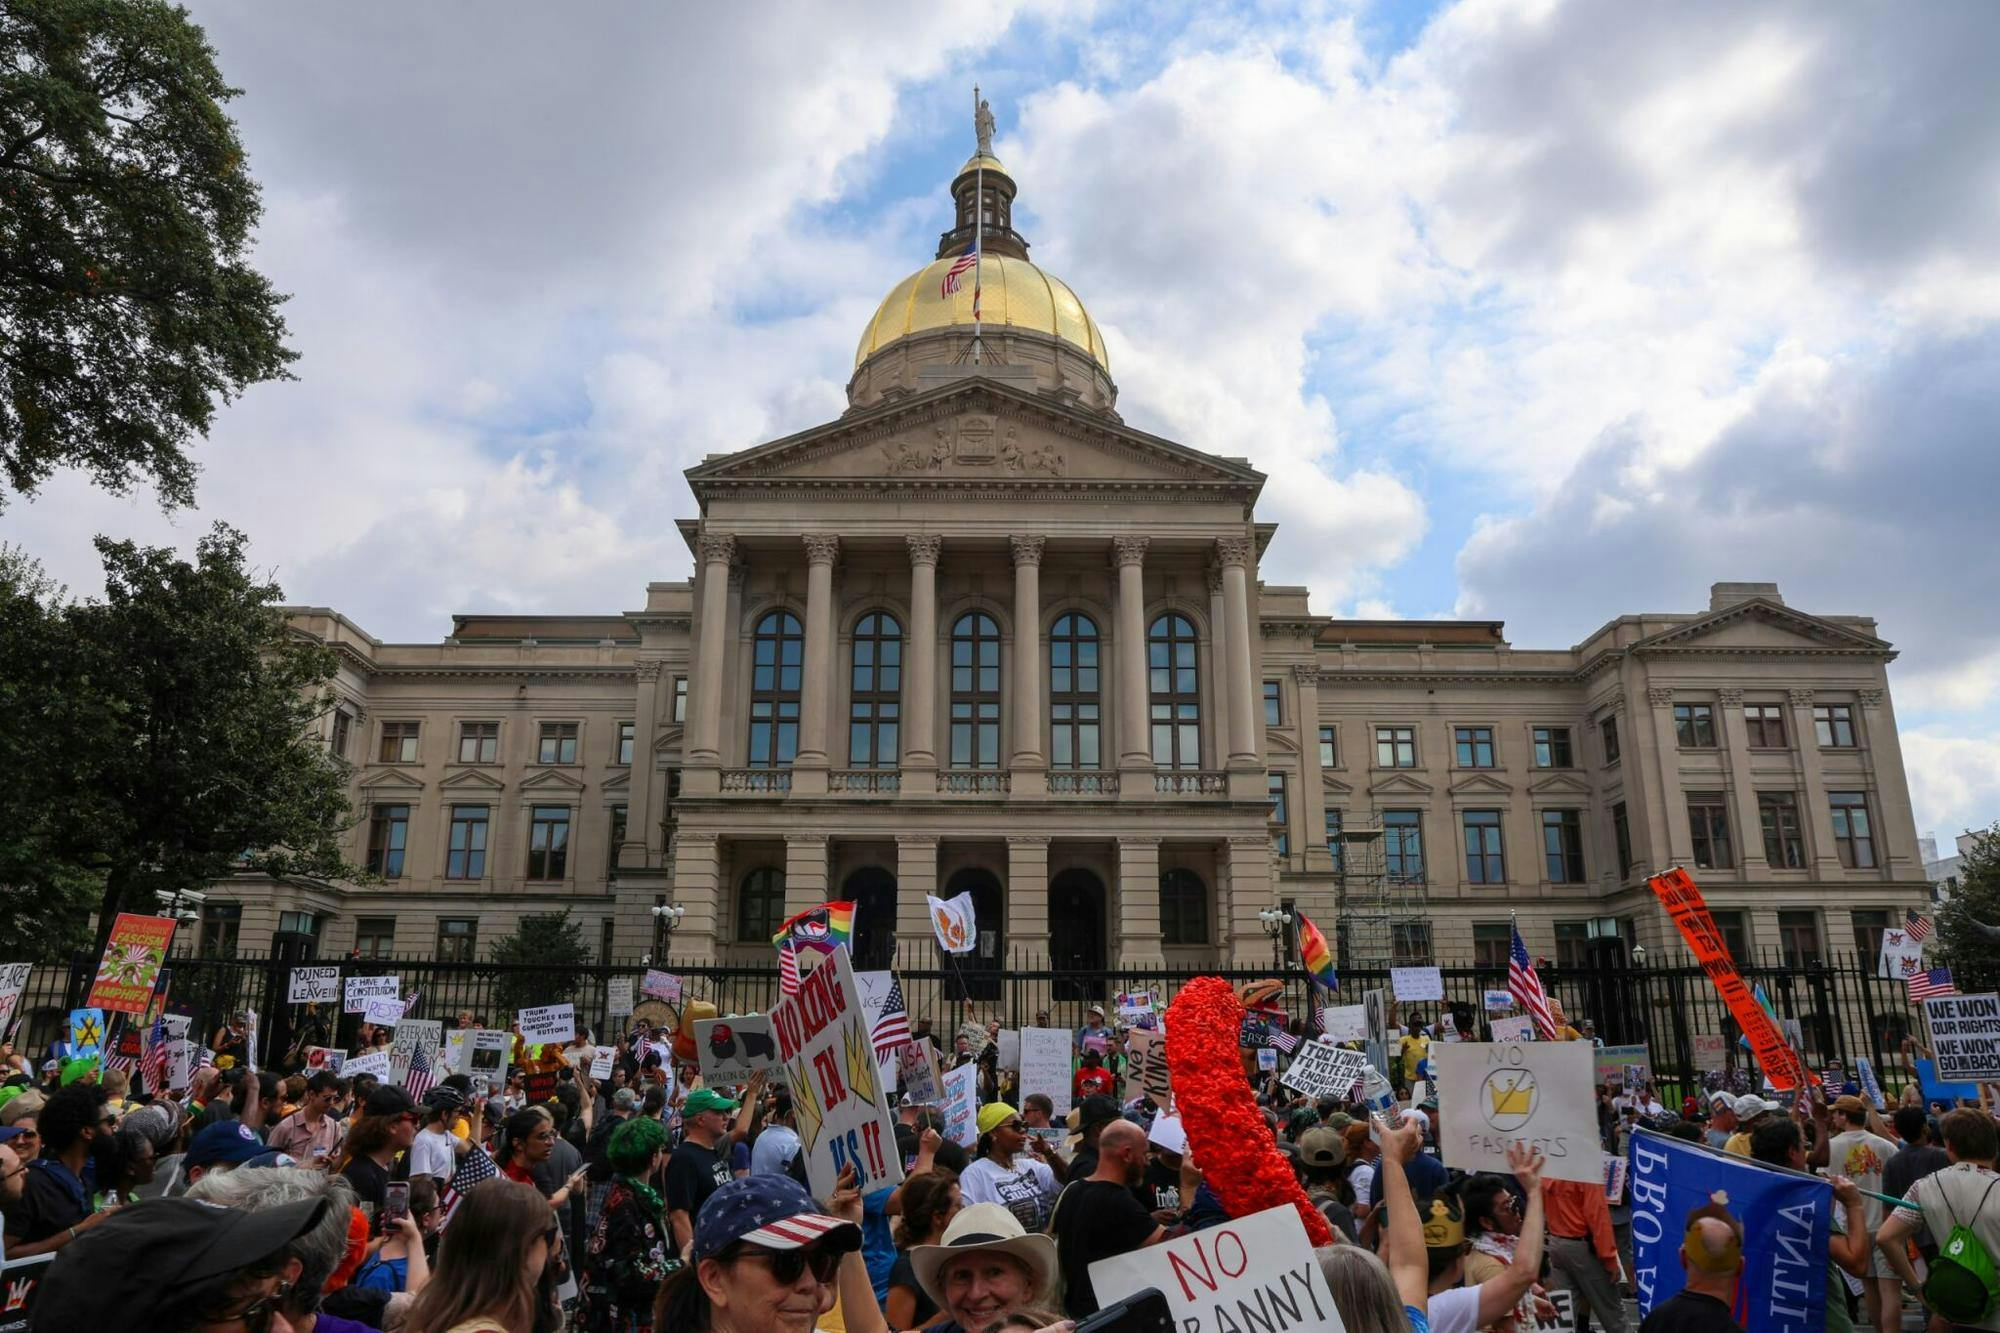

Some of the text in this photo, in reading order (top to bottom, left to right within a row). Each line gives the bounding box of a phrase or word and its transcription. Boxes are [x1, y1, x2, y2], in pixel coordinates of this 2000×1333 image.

[116, 931, 166, 945] FASCISM
[4, 965, 30, 989] ARE
[312, 967, 336, 979] NEED
[306, 980, 320, 990] TO
[346, 979, 356, 987] WE
[360, 978, 377, 986] HAVE
[95, 986, 149, 1002] AMPHIFA
[346, 998, 363, 1009] NOT
[772, 955, 847, 1064] NO KING
[1926, 999, 1998, 1019] WE WON
[523, 1014, 556, 1023] TOUCHES
[525, 1008, 548, 1017] TRUMP
[395, 1025, 440, 1040] VETERANS
[522, 1021, 553, 1031] GUMDROP
[537, 1026, 569, 1036] BUTTONS
[1932, 1019, 2000, 1035] OUR RIGHTS
[900, 1042, 926, 1069] USA
[1487, 1046, 1524, 1065] NO
[1935, 1040, 1960, 1055] WE
[1306, 1044, 1367, 1068] TOO YOUNG
[1938, 1056, 1958, 1070] GO
[1129, 1049, 1144, 1082] NO
[1143, 1039, 1170, 1097] KINGS
[1296, 1055, 1364, 1079] TO VOTE OLD
[1282, 1074, 1348, 1098] KNOW BETTER
[1300, 1068, 1350, 1088] ENOUGH TO
[1167, 1230, 1248, 1302] NO
